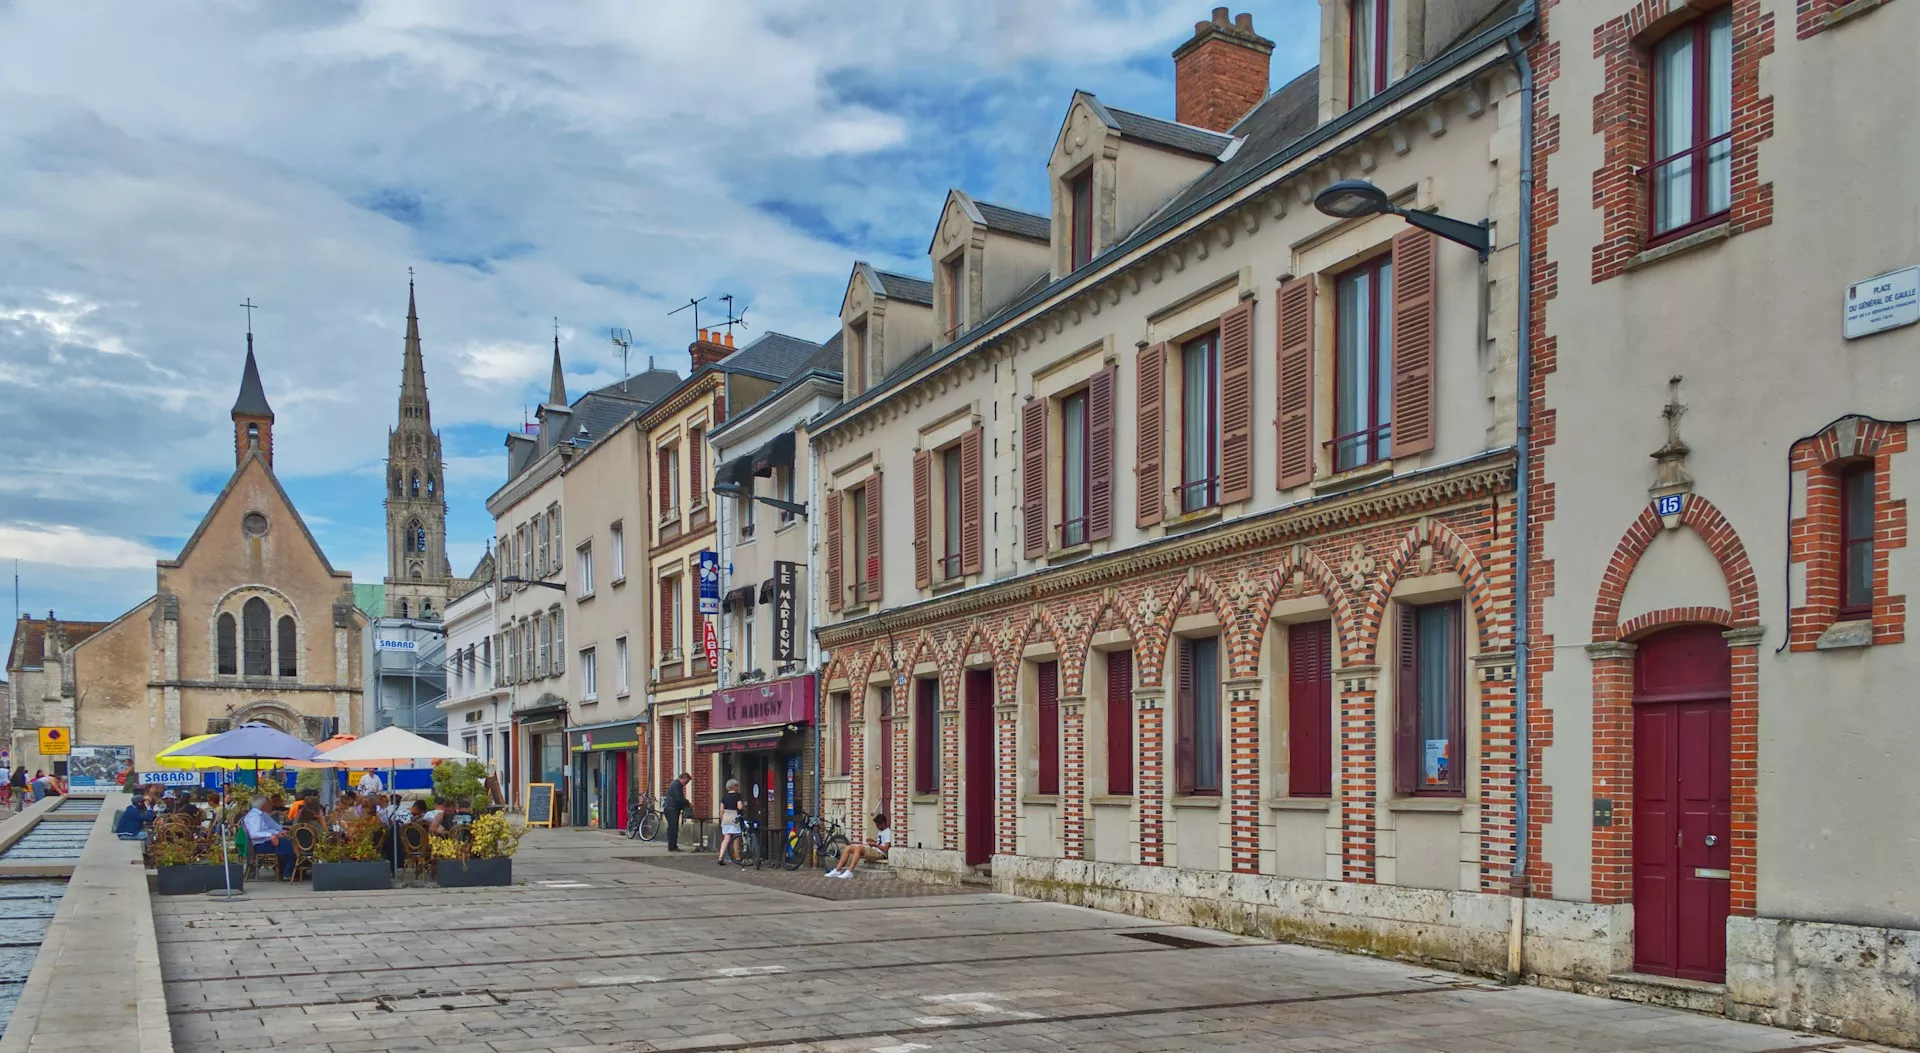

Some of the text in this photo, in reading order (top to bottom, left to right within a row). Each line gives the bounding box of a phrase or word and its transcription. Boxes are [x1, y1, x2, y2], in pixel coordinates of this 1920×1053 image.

[1873, 283, 1891, 294] PLACE
[1848, 304, 1858, 312] DU
[1884, 294, 1893, 303] DE
[1894, 288, 1916, 300] GAULLE
[1661, 496, 1679, 513] 15
[779, 564, 791, 658] LE MARIGNY
[380, 640, 415, 649] SABARD
[705, 623, 717, 667] TABAC
[727, 700, 783, 720] LE MARIGNY
[145, 772, 194, 782] SABARD
